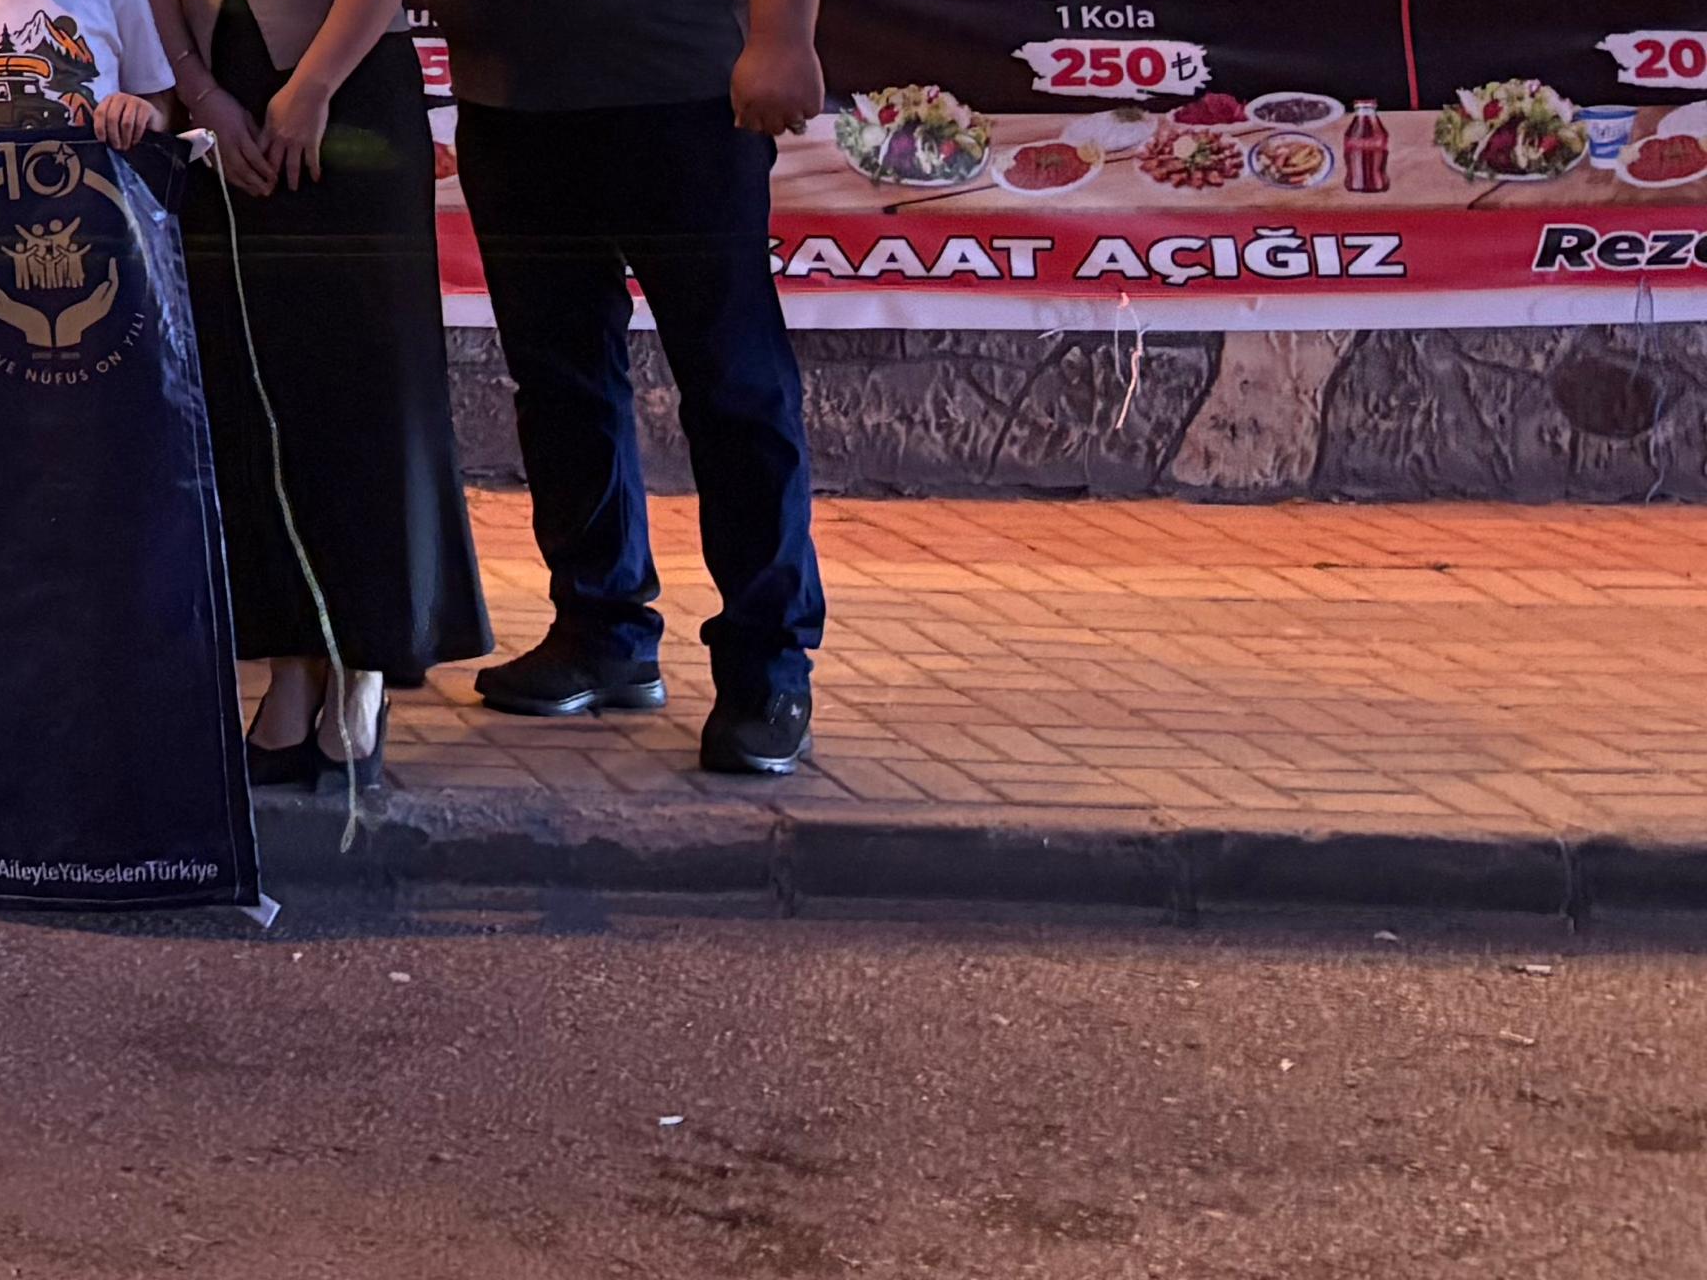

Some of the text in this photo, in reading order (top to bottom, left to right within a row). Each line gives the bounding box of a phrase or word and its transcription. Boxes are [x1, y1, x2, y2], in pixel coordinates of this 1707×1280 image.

[1056, 5, 1155, 29] 1 Kola
[1076, 228, 1406, 285] AÇIĞIZ
[1531, 223, 1707, 272] Rez
[95, 351, 122, 373] ON
